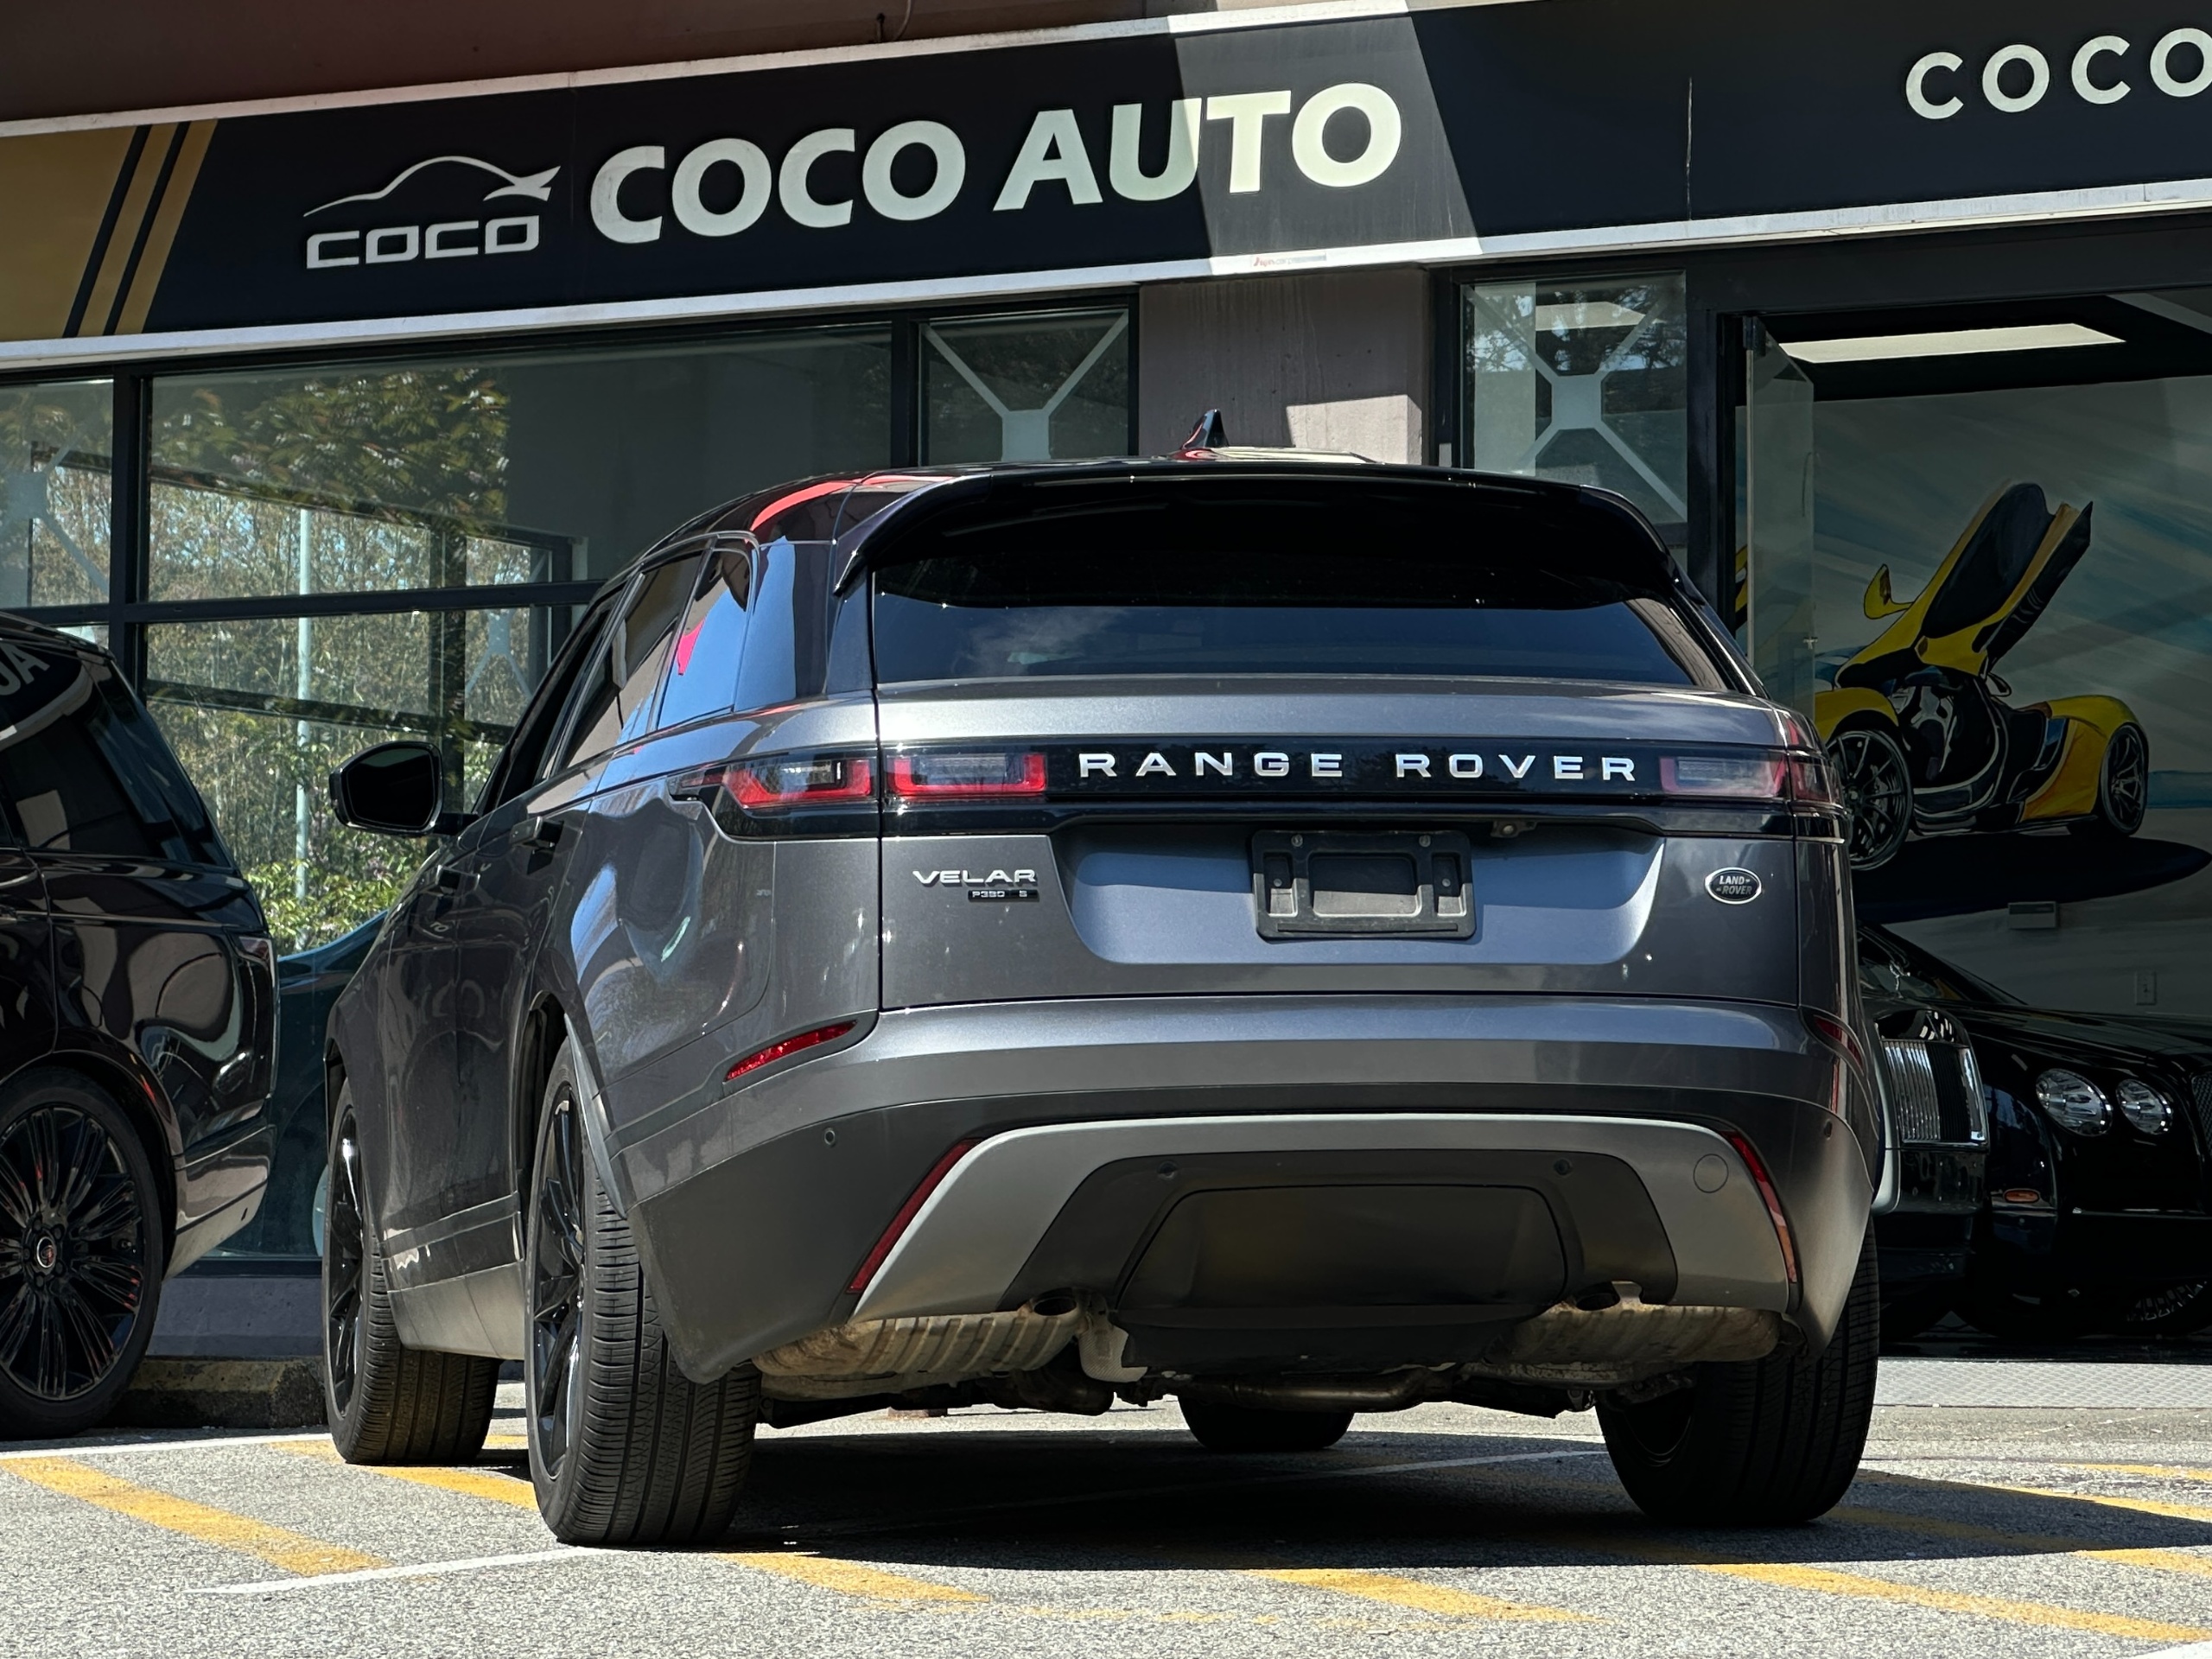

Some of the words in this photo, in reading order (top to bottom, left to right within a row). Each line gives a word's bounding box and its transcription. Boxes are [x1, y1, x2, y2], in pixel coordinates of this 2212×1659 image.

[1906, 28, 2212, 119] COCO
[590, 119, 966, 244] COCO
[993, 83, 1402, 211] AUTO
[306, 215, 540, 269] COCO
[1078, 752, 1344, 778] RANGE
[1395, 753, 1637, 781] ROVER
[912, 869, 1036, 884] VELAR
